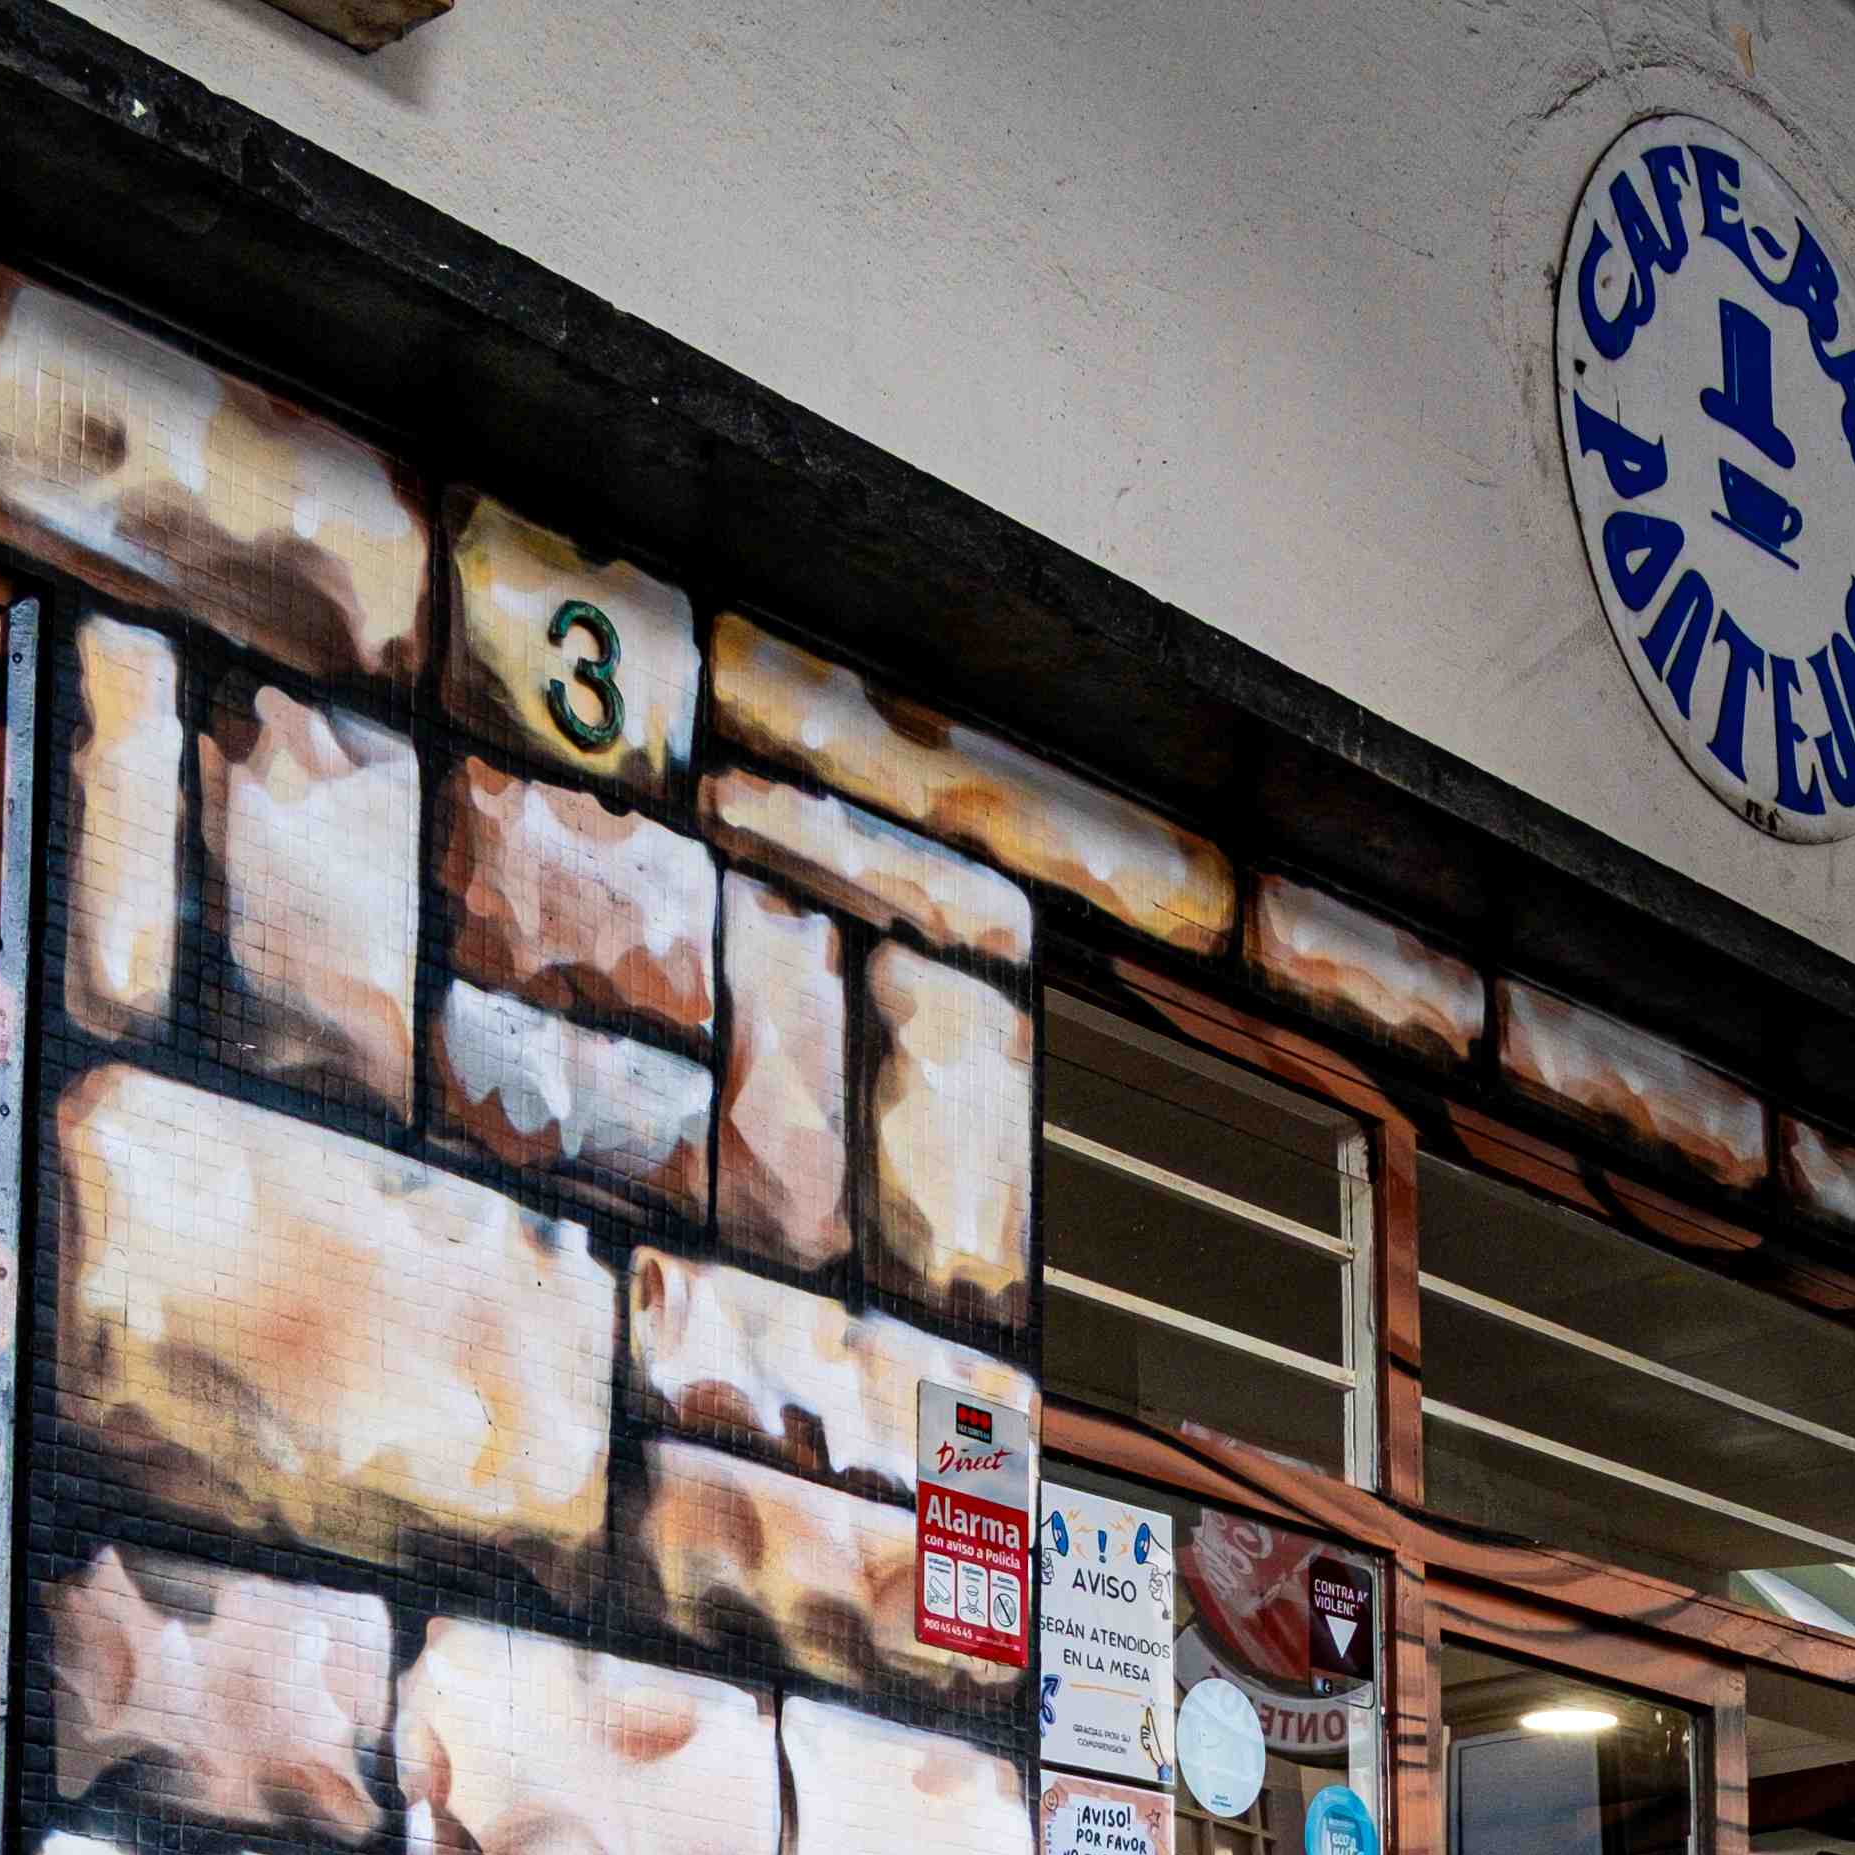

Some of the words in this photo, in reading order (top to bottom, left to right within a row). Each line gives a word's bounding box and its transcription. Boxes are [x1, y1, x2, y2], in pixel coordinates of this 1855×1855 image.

[546, 600, 626, 753] 3
[936, 1440, 1013, 1474] Direct
[925, 1494, 1021, 1550] Alarma
[924, 1533, 944, 1549] con
[946, 1538, 975, 1558] aviso
[976, 1549, 984, 1559] a
[1314, 1579, 1356, 1600] CONTRA
[1040, 1615, 1086, 1640] SERÁN
[1089, 1627, 1171, 1659] ATENDIDOS
[1063, 1649, 1083, 1667] EN
[1086, 1654, 1105, 1673] LA
[1108, 1659, 1151, 1683] MESA
[1077, 1805, 1131, 1831] ¡AVISO!
[1076, 1828, 1102, 1848] POR
[1106, 1833, 1147, 1855] FAVOR
